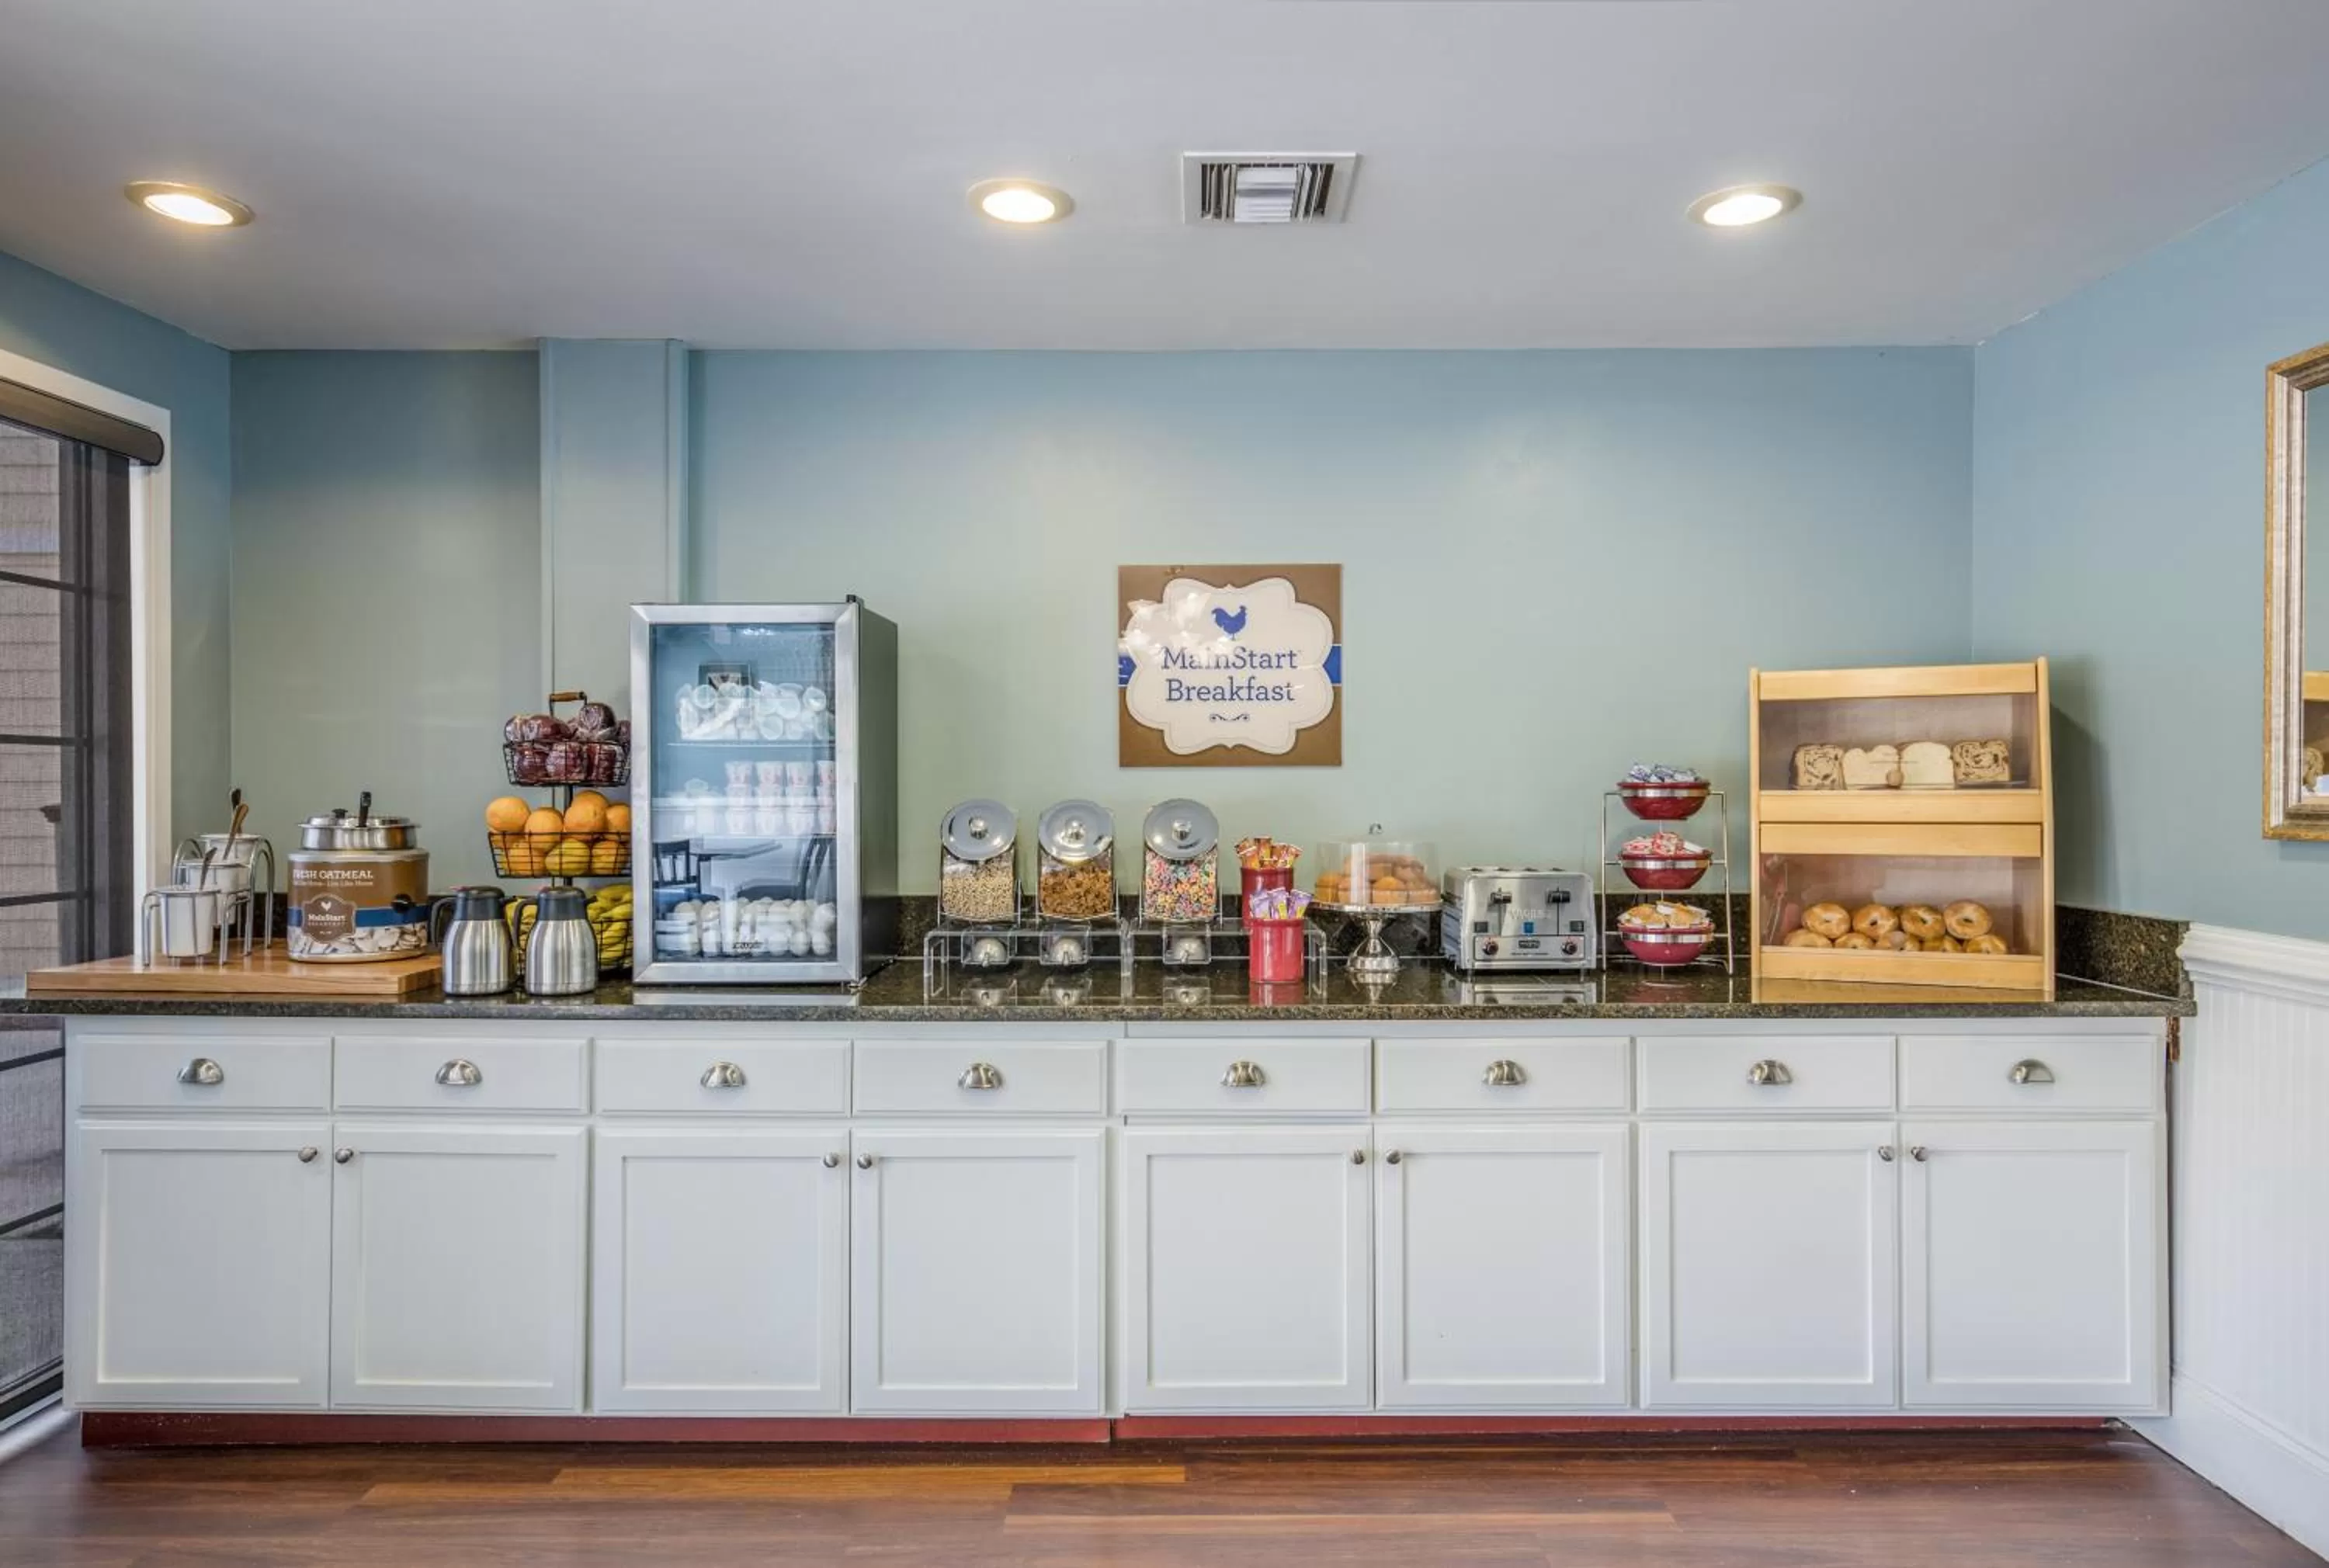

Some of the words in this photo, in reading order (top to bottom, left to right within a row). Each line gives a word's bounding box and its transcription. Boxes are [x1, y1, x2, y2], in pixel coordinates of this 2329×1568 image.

[1161, 646, 1299, 670] MainStart
[1165, 675, 1296, 702] Breakfast
[318, 869, 374, 879] OATMEAL
